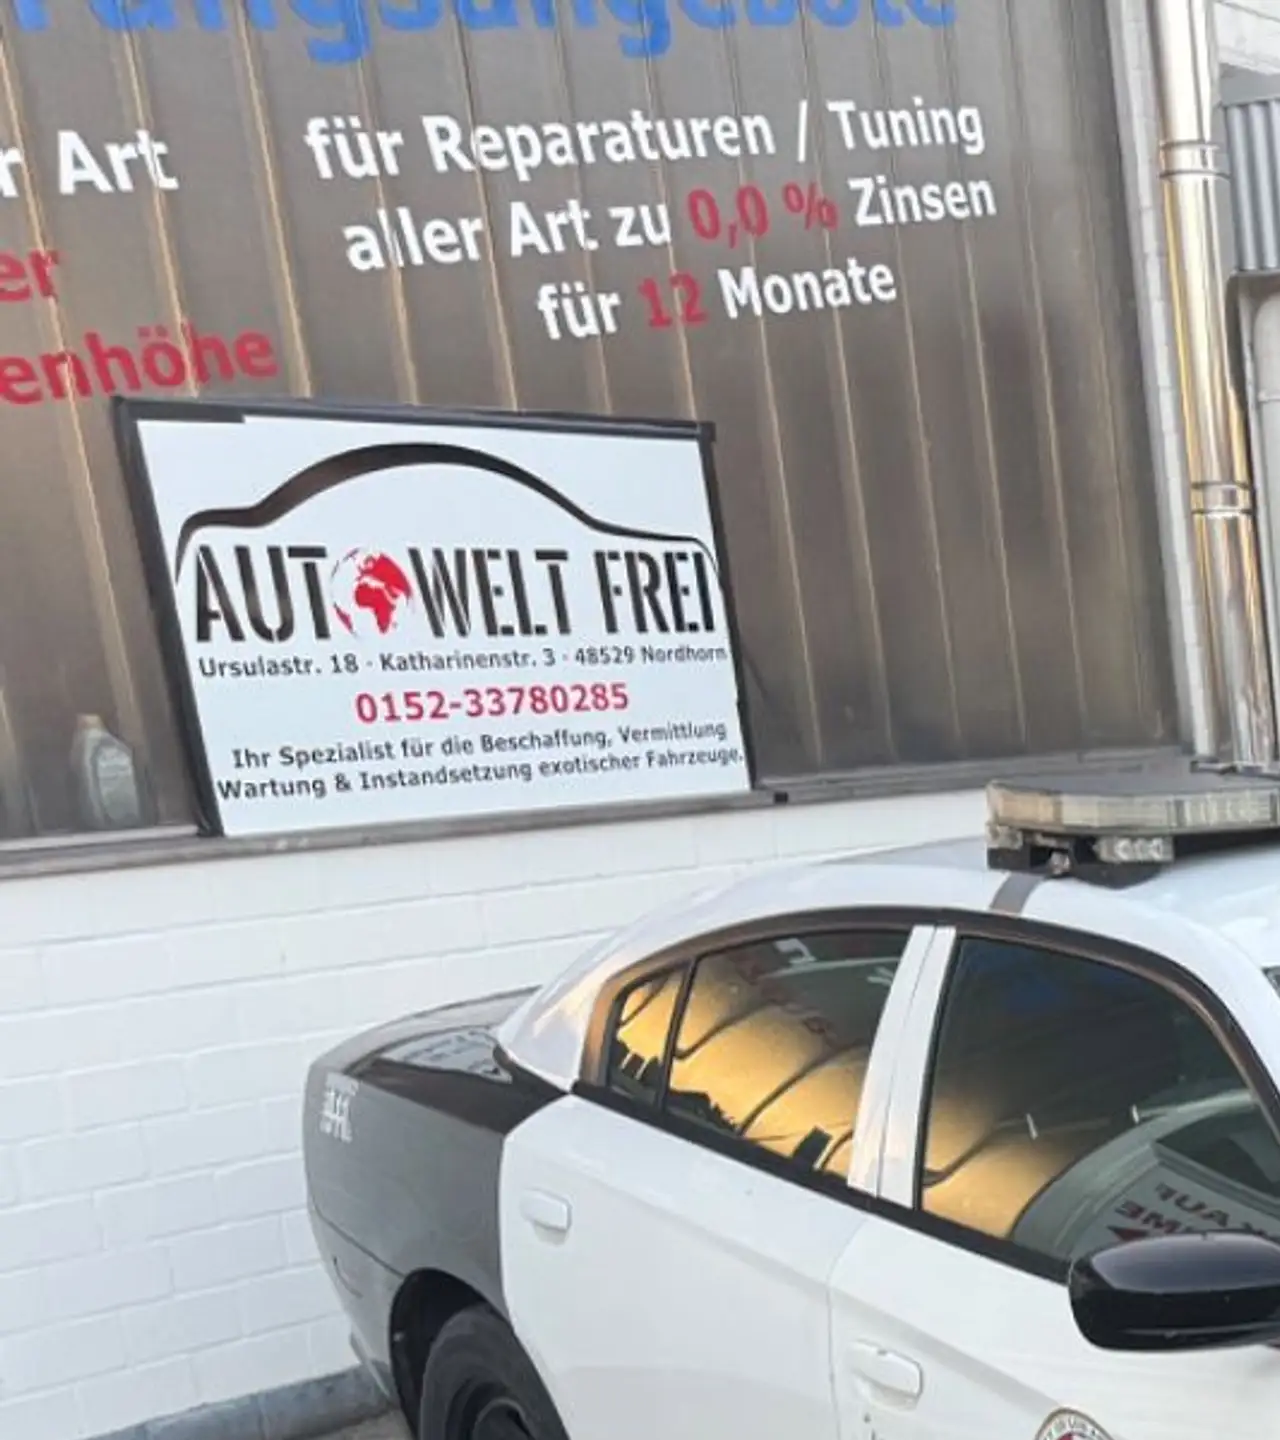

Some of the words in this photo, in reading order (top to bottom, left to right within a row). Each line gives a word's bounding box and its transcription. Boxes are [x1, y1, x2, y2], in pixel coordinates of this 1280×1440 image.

[58, 130, 180, 194] Art
[304, 115, 403, 180] für
[421, 109, 776, 181] Reparaturen
[797, 100, 809, 162] /
[828, 96, 985, 156] Tuning
[343, 206, 484, 272] aller
[509, 200, 599, 257] Art
[609, 202, 671, 247] zu
[687, 184, 769, 249] 0,0
[782, 181, 839, 231] %
[849, 175, 997, 227] Zinsen
[536, 283, 621, 341] für
[637, 272, 707, 329] 12
[717, 257, 898, 319] Monate
[407, 547, 571, 639] WELT
[594, 549, 715, 634] FREI
[198, 655, 322, 678] Ursulastr.
[330, 653, 359, 674] 18
[379, 649, 537, 673] Katharinenstr.
[543, 648, 556, 667] 3
[574, 646, 636, 666] 48529
[640, 645, 728, 665] Nordhorn
[355, 682, 630, 724] 0152-33780285
[217, 775, 327, 801] Wartung
[335, 771, 353, 794] &
[358, 762, 532, 791] Instandsetzung
[539, 751, 640, 777] exotischer
[645, 746, 744, 770] Fahrzeuge.
[232, 748, 271, 769] Ihr
[279, 740, 394, 770] Spezialist
[400, 736, 435, 758] für
[440, 733, 474, 755] die
[617, 720, 728, 743] Vermittlung
